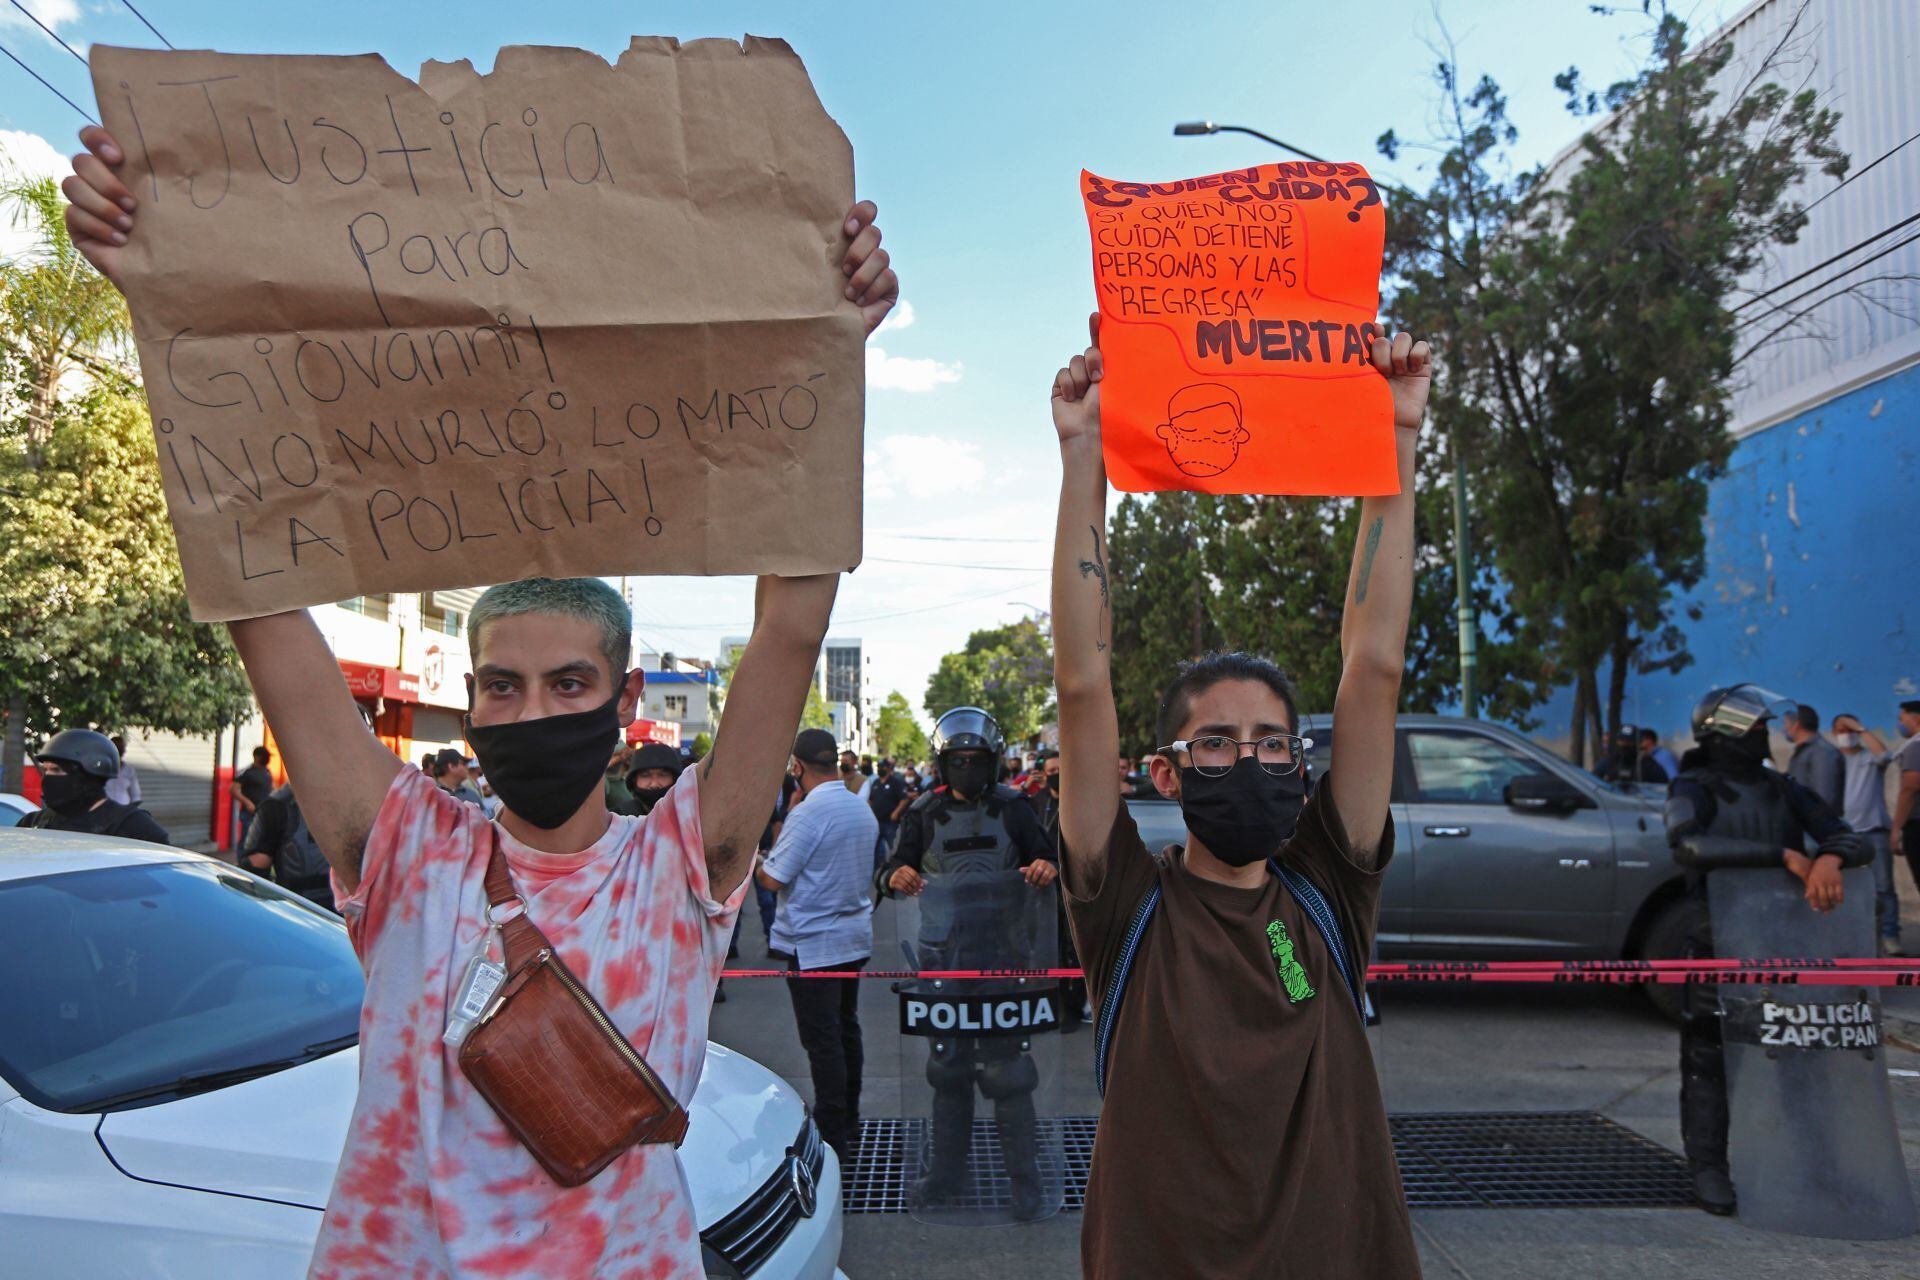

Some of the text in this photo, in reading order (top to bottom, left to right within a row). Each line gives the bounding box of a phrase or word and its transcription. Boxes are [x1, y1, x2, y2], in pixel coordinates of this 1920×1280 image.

[1278, 162, 1361, 179] NOS
[1193, 223, 1294, 250] DETIENE
[1099, 251, 1297, 288] PERSONAS Y LAS
[592, 402, 660, 447] LO
[676, 372, 827, 440] MATÓ
[236, 458, 662, 580] LA POLICÍA!
[906, 997, 1056, 1031] POLICIA
